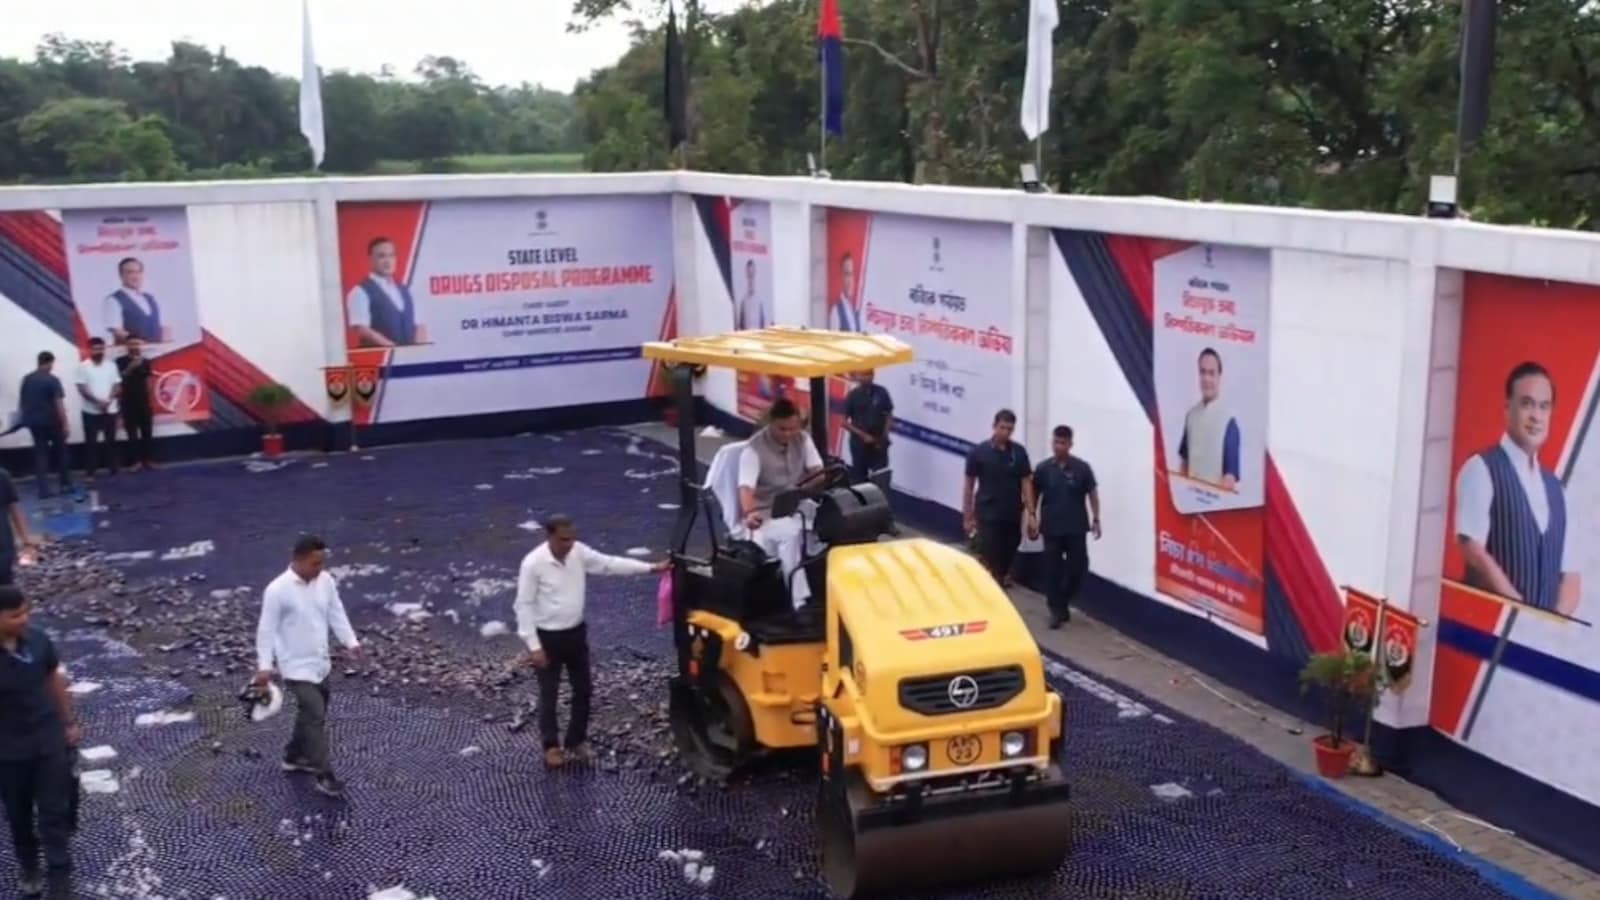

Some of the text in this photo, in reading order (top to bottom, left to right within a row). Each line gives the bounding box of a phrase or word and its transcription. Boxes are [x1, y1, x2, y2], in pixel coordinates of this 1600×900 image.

[508, 248, 578, 266] STATE LEVEL
[430, 265, 653, 295] DRUGS DISPOSAL PROGRAMME
[461, 308, 628, 330] DR HIMANTA BISWA SARMA
